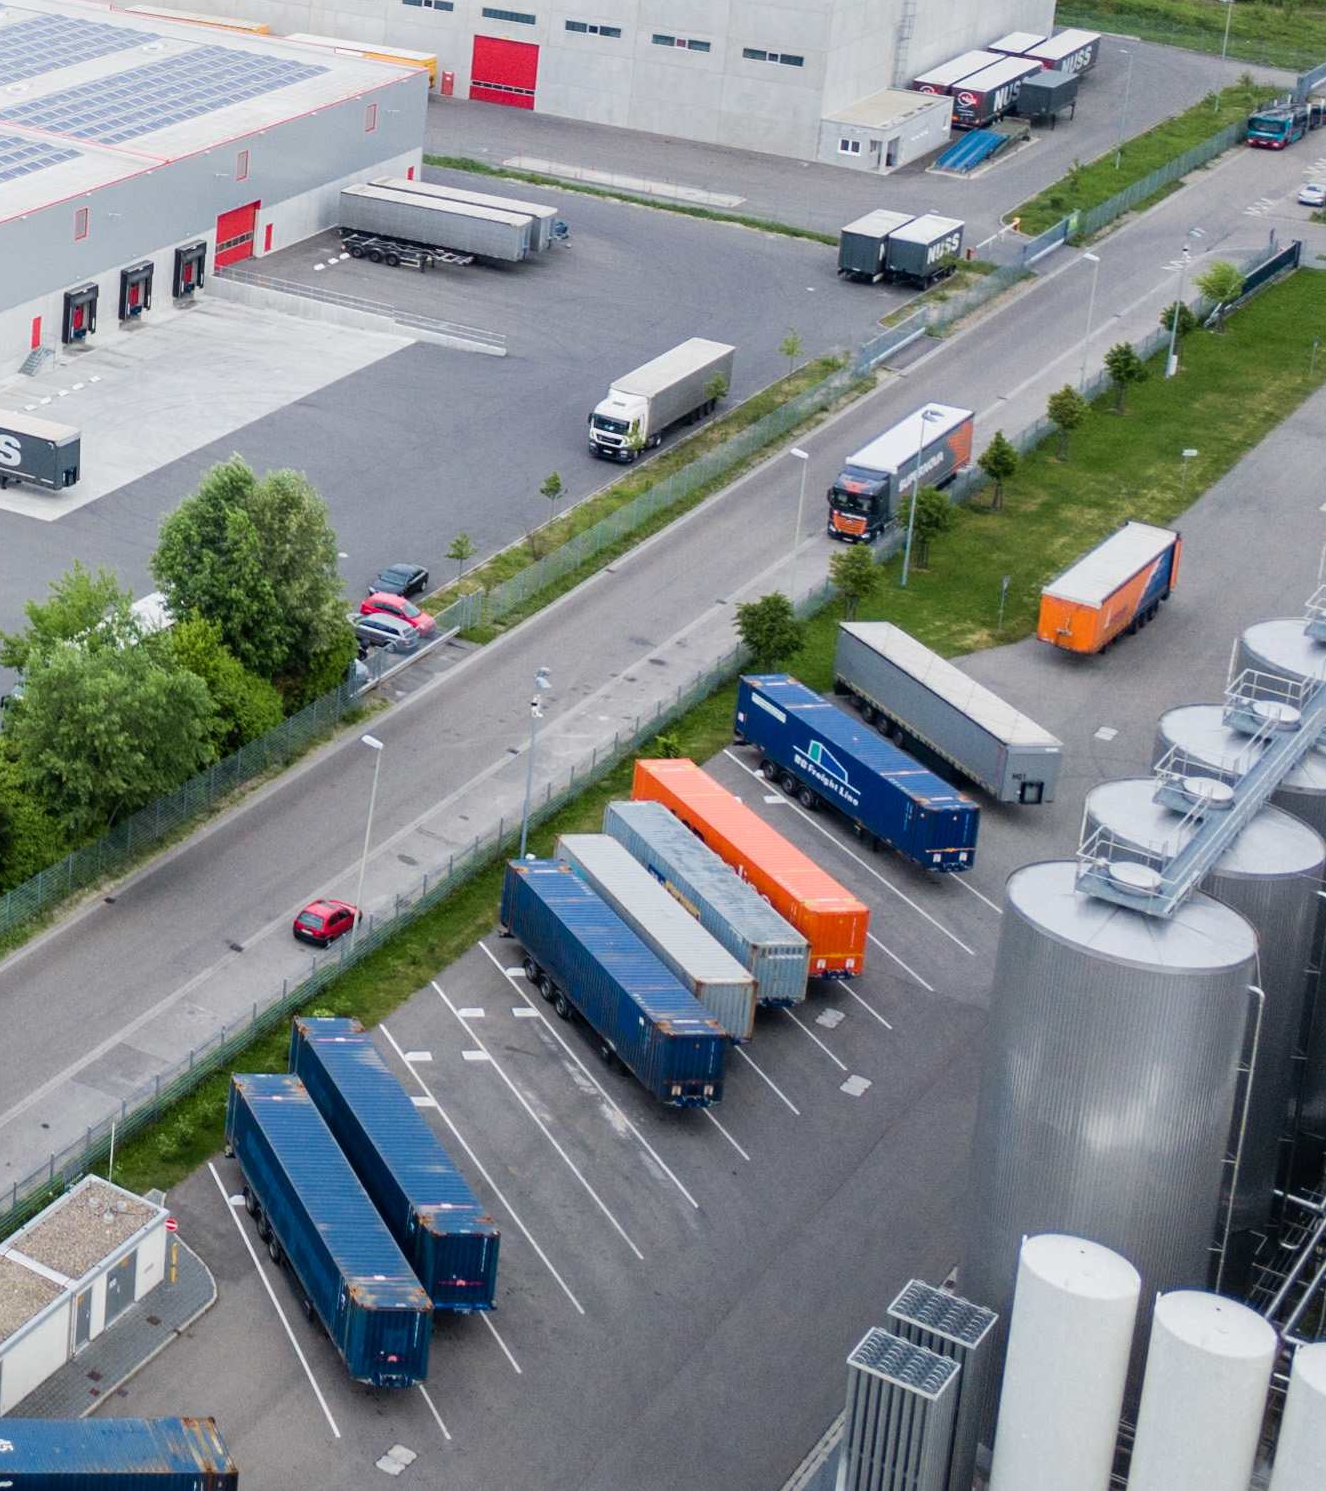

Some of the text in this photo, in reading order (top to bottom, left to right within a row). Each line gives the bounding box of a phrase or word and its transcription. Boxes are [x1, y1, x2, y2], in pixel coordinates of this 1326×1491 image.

[1062, 45, 1092, 74] NUSS
[808, 763, 839, 792] Freight
[838, 786, 859, 807] Line
